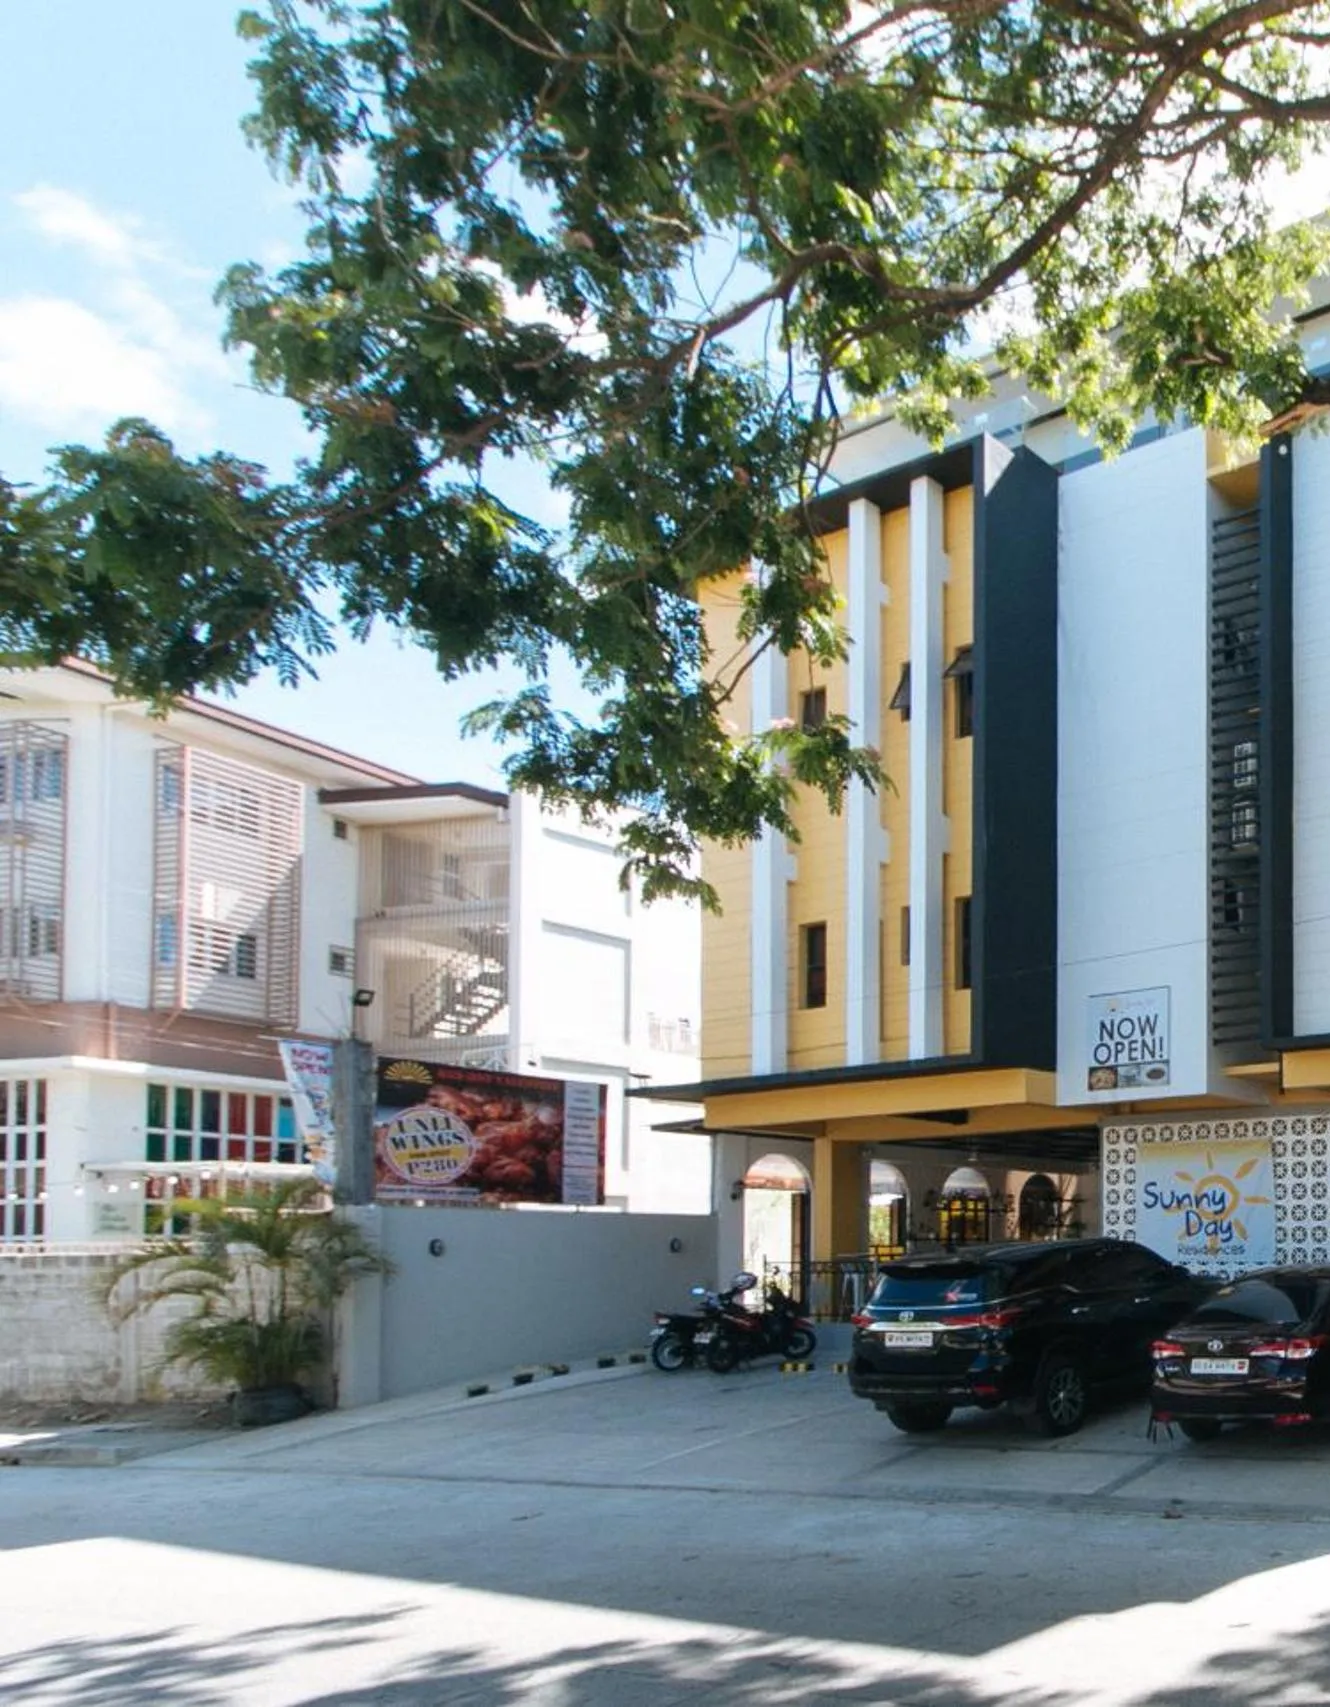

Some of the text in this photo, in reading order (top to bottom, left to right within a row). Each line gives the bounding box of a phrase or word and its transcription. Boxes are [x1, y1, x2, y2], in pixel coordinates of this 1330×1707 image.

[1099, 1013, 1158, 1042] NOW
[1093, 1036, 1164, 1065] OPEN!
[389, 1132, 465, 1150] WINGS
[1143, 1181, 1227, 1215] Sunny
[1185, 1209, 1234, 1243] Day
